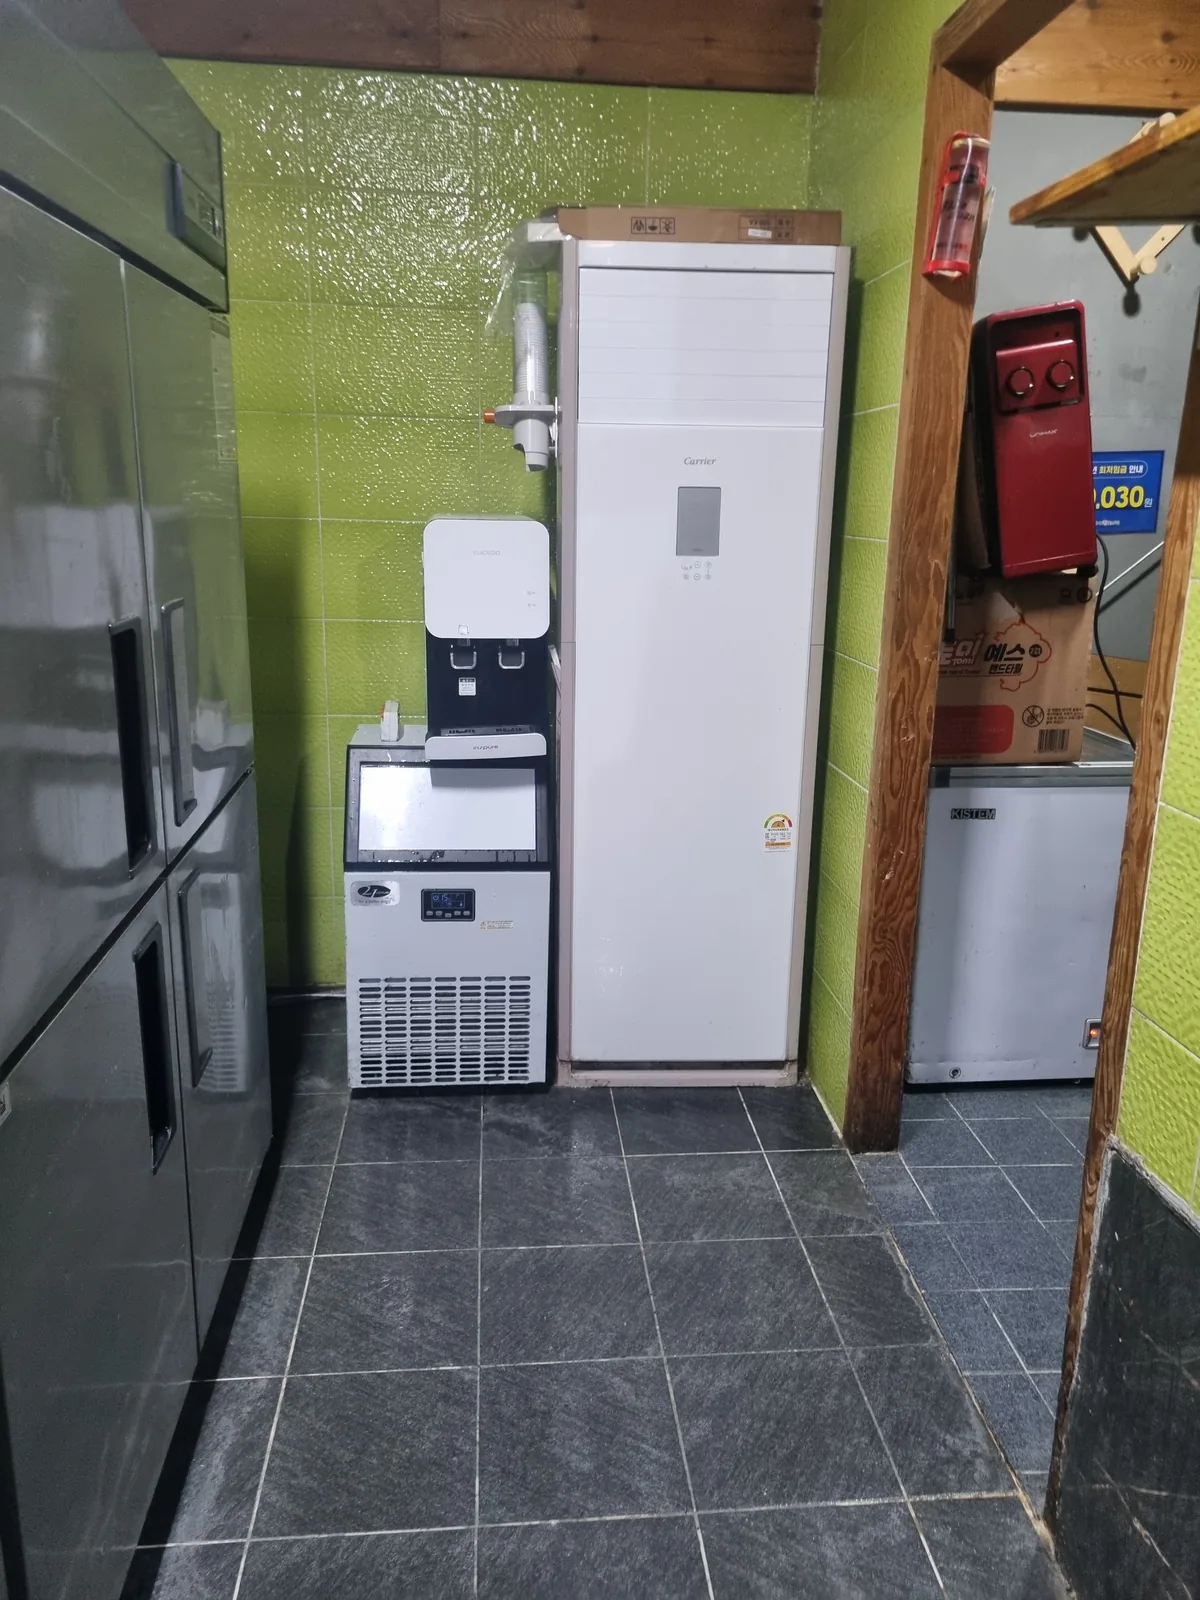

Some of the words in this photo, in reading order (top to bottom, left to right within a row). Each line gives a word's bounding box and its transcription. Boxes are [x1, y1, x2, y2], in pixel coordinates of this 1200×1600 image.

[683, 456, 717, 466] Carrier
[1099, 465, 1127, 474] 최저임금
[1128, 464, 1144, 474] 안내
[951, 808, 996, 820] KISTEM
